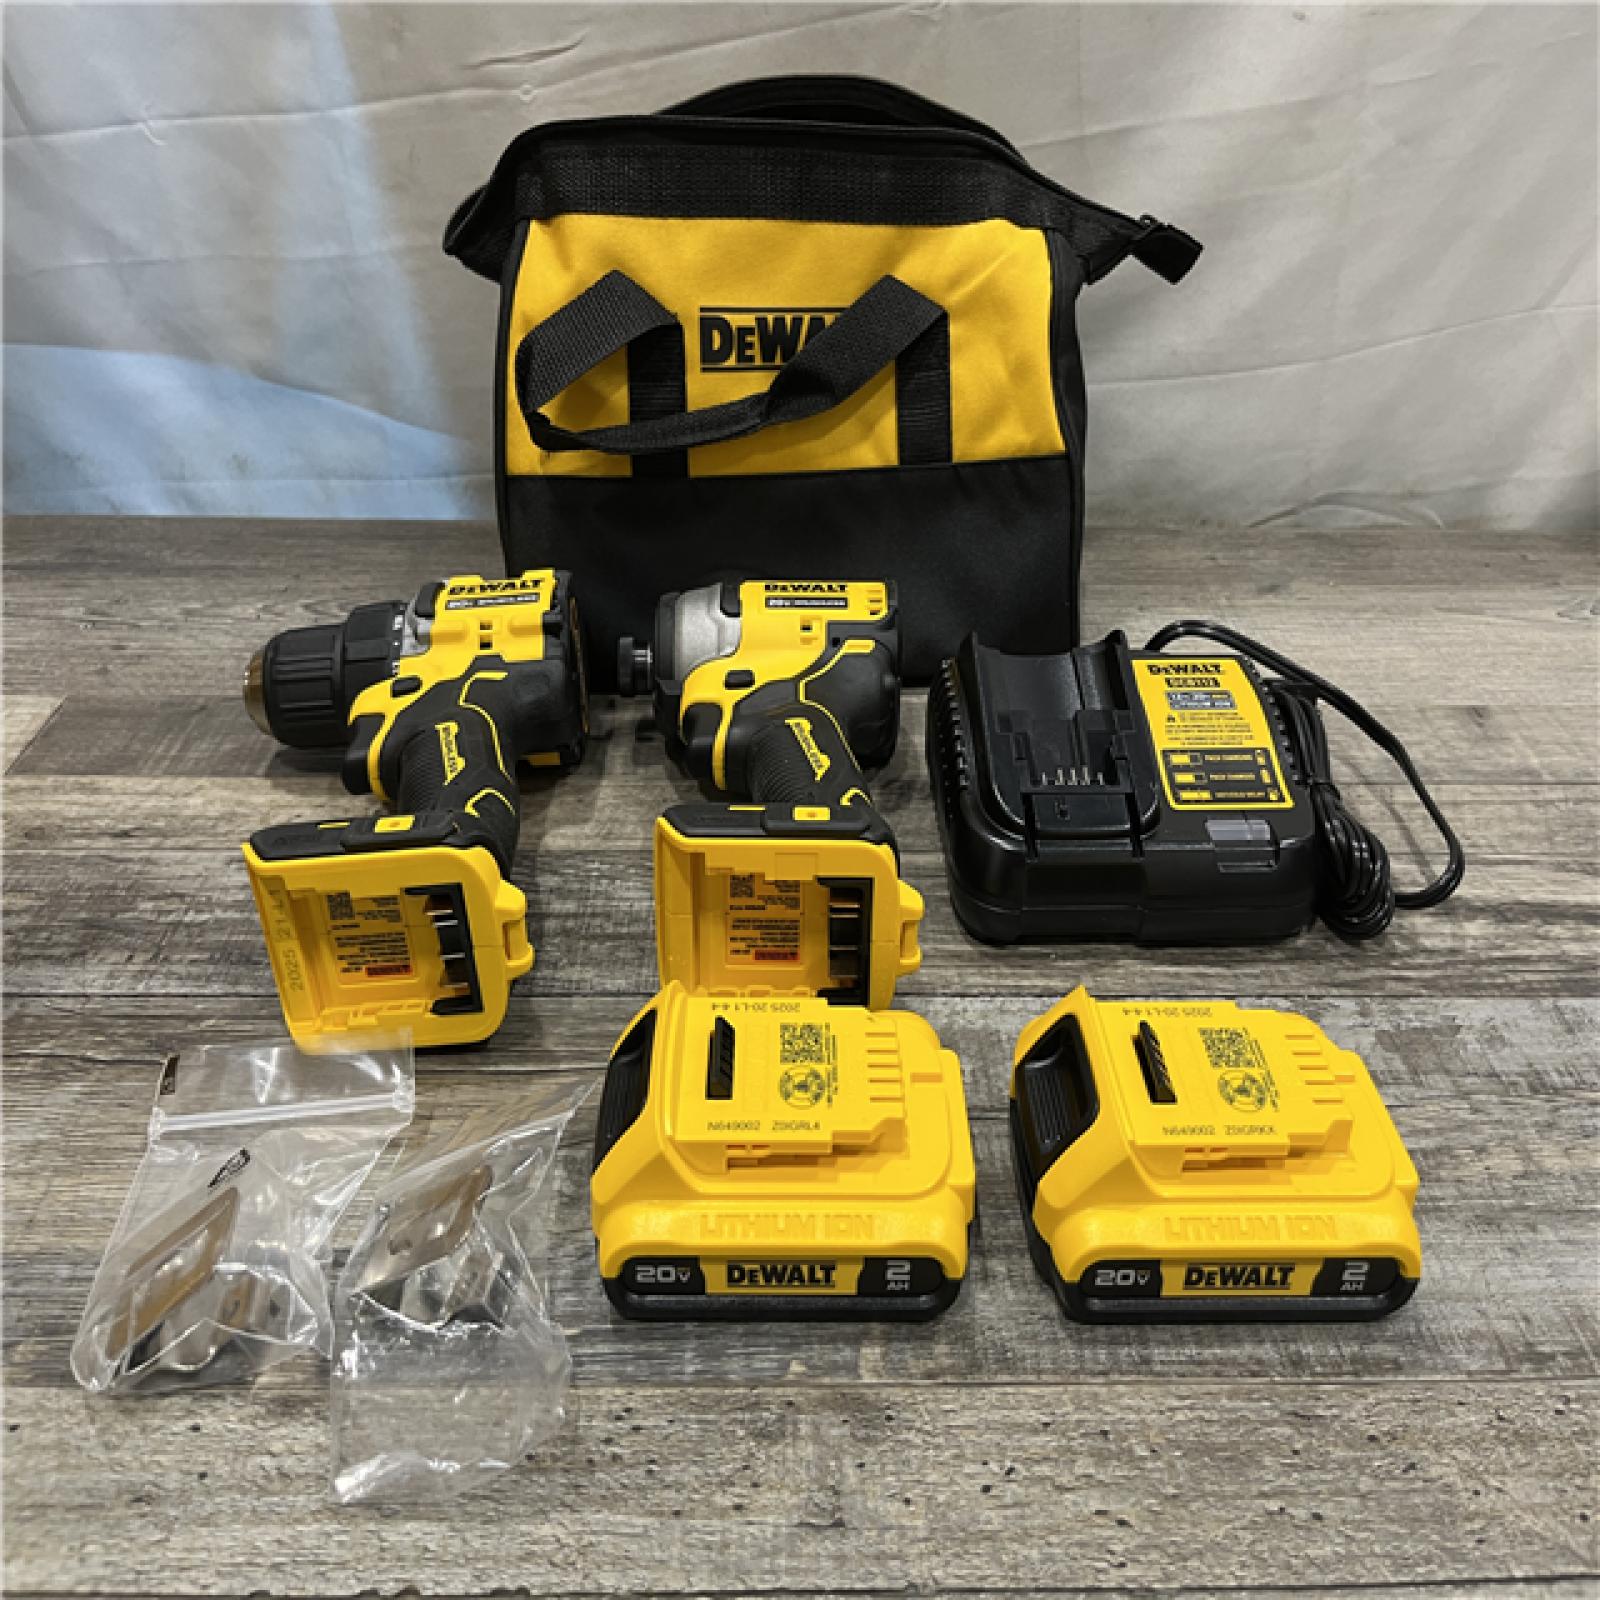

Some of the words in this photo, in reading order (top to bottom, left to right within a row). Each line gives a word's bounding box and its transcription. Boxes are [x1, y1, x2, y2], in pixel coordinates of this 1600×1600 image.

[699, 316, 836, 364] DEW
[700, 1214, 816, 1241] LITHIUM
[825, 1214, 874, 1241] ION
[1164, 1215, 1280, 1242] LITHIUM
[1287, 1215, 1338, 1242] ION
[726, 1262, 836, 1286] DEWALT
[886, 1260, 911, 1281] 2
[1183, 1265, 1296, 1287] DEWALT
[1341, 1261, 1370, 1281] 2
